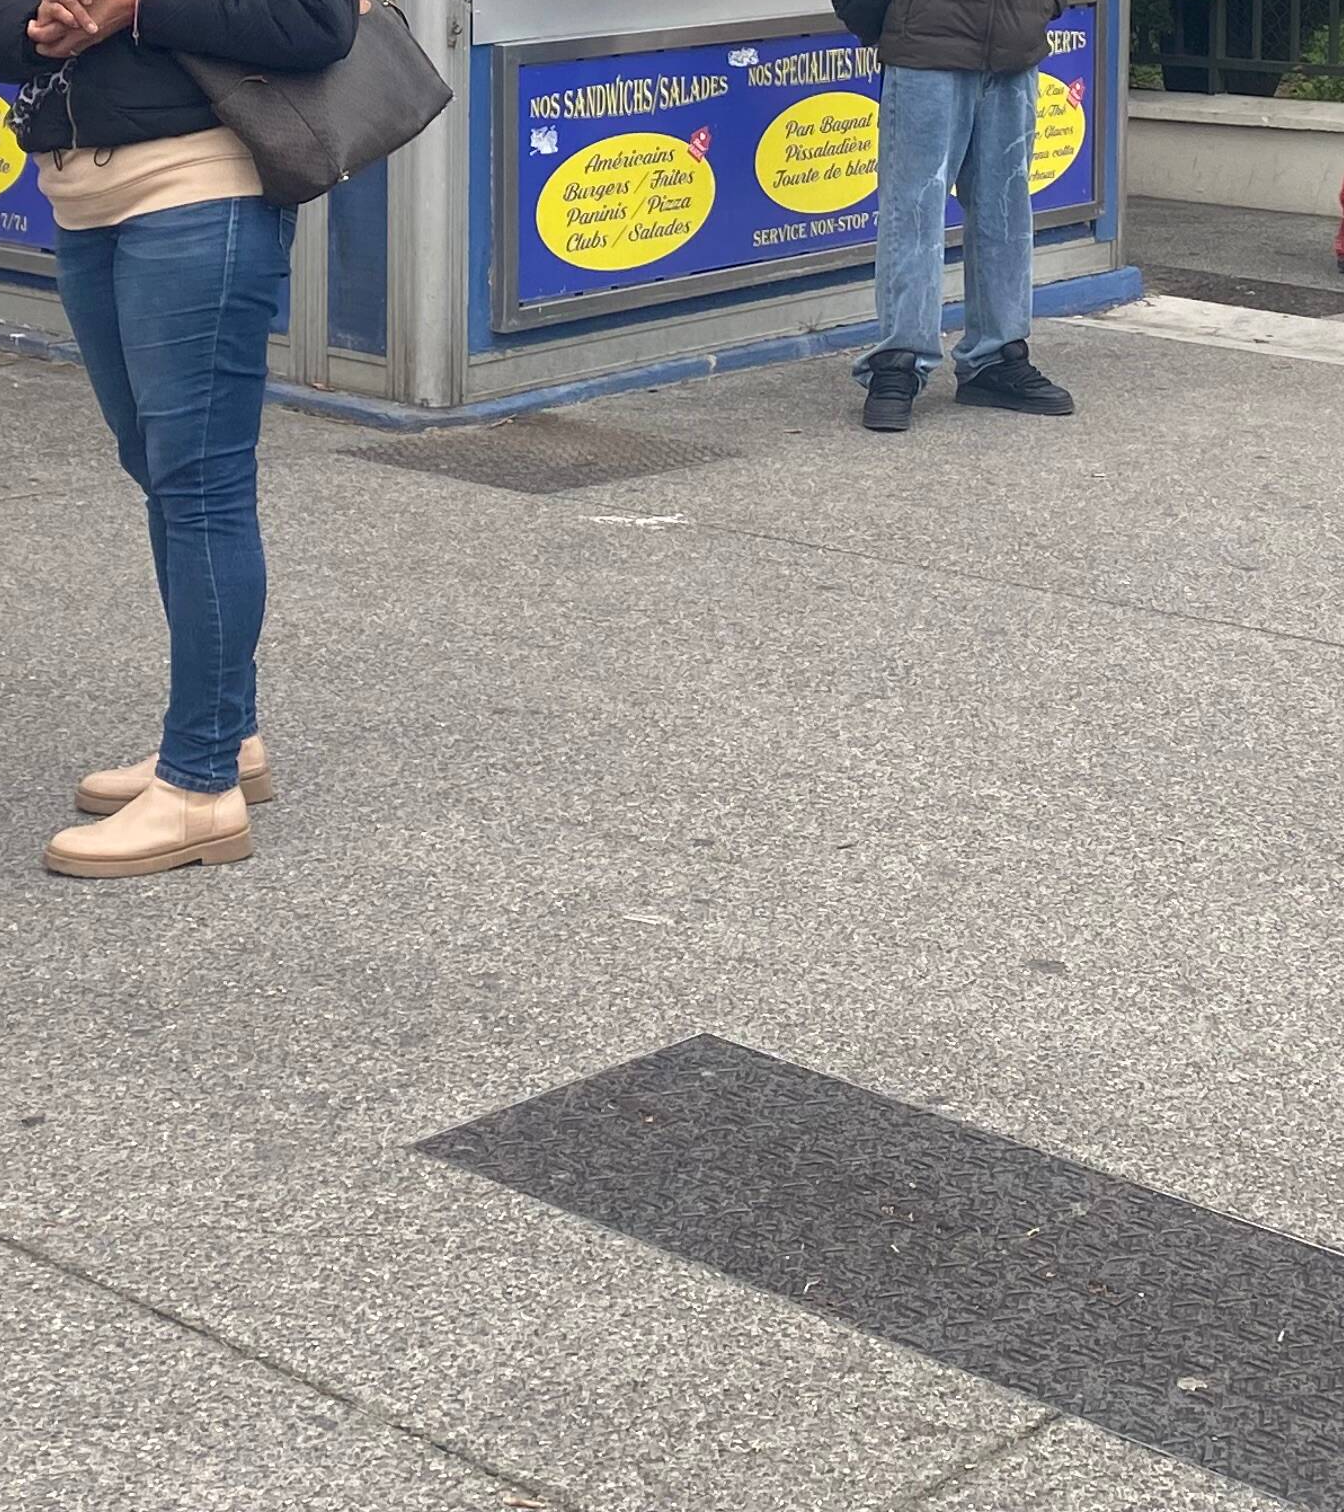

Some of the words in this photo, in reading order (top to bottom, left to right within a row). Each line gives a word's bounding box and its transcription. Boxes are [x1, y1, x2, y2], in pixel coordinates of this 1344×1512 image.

[1046, 30, 1087, 56] SERTS
[748, 62, 773, 87] NOS
[774, 47, 853, 88] SPECIALITES
[529, 93, 561, 119] NOS
[785, 120, 815, 139] Pan
[584, 147, 676, 174] Américains
[785, 136, 871, 163] Pissaladière
[823, 163, 842, 180] de
[563, 180, 631, 202] Burgers
[650, 169, 696, 191] Frites
[567, 203, 628, 228] Paninis
[647, 195, 692, 215] Pizza
[566, 231, 608, 253] Clubs
[628, 219, 692, 242] Salades
[752, 222, 807, 248] SERVICE
[809, 212, 870, 238] NON-STOP
